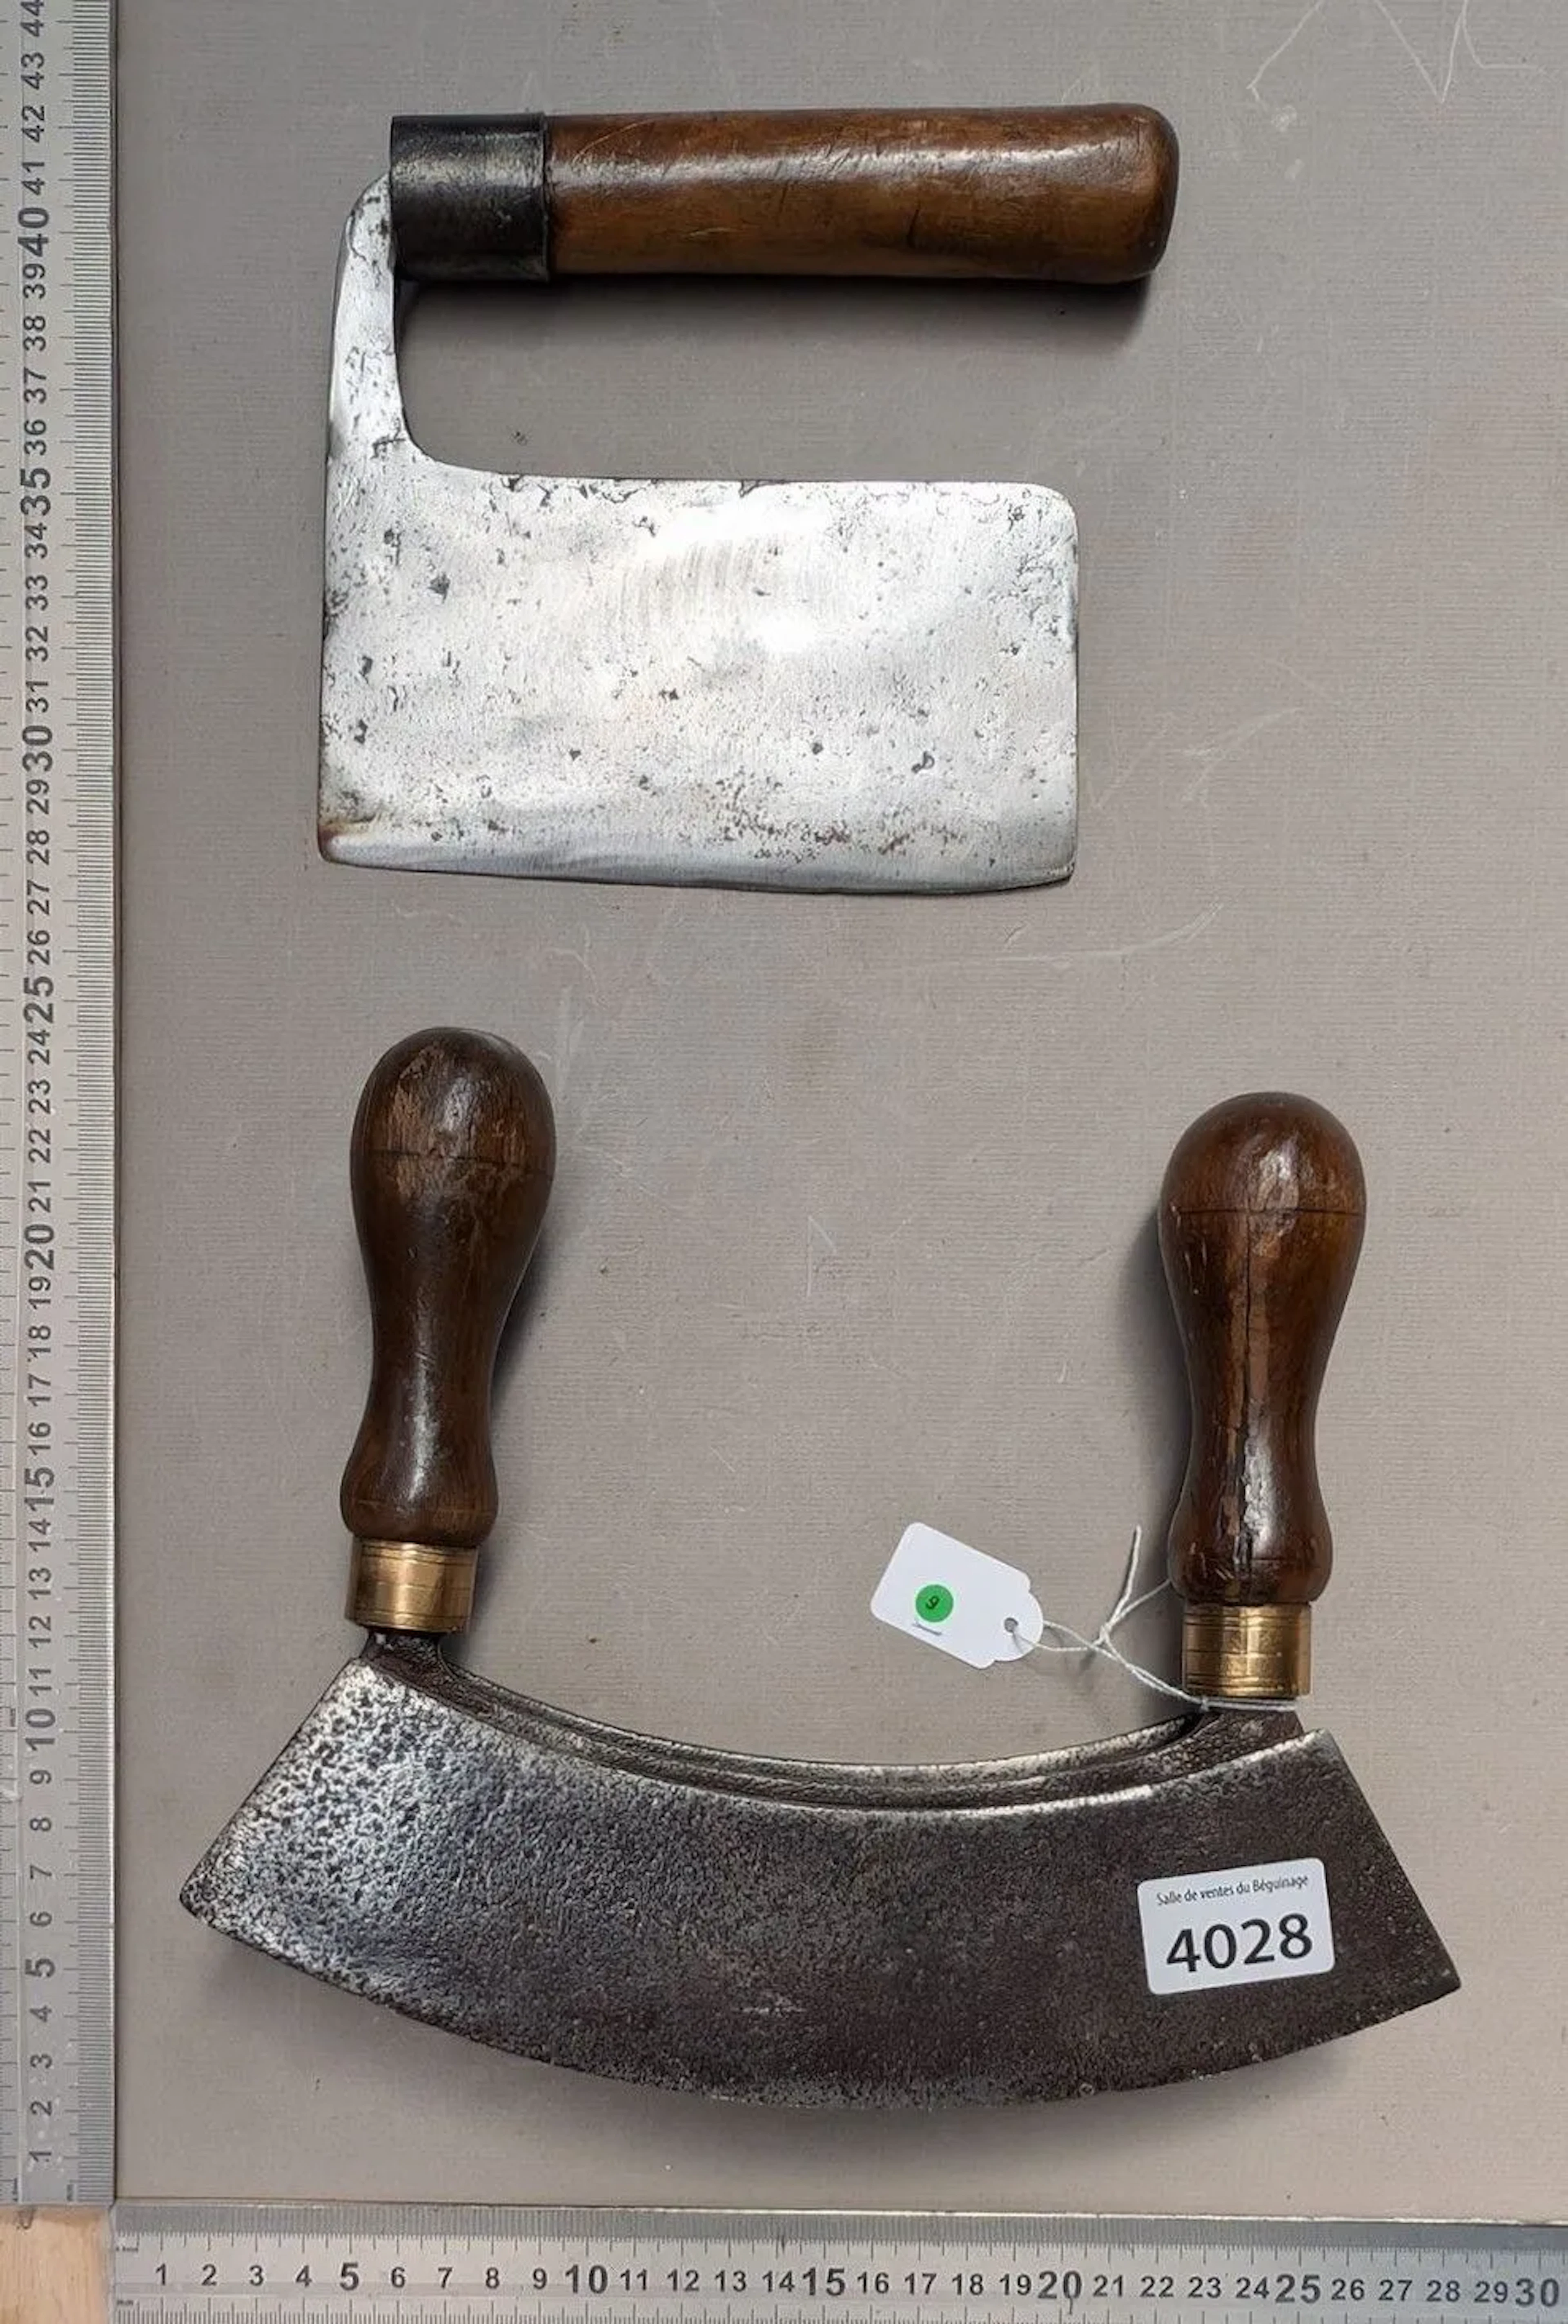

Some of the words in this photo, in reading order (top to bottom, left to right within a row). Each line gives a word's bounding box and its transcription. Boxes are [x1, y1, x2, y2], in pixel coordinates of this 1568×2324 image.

[20, 0, 45, 38] 44
[20, 52, 45, 91] 43
[21, 105, 45, 143] 42
[21, 161, 45, 196] 41
[17, 207, 50, 257] 40
[22, 263, 46, 300] 39
[22, 315, 47, 357] 38
[22, 366, 47, 404] 37
[23, 419, 47, 456] 36
[19, 468, 51, 517] 35
[24, 522, 48, 560] 34
[24, 575, 49, 611] 33
[24, 626, 49, 662] 32
[25, 680, 49, 714] 31
[21, 725, 53, 772] 30
[25, 779, 50, 815] 29
[25, 830, 50, 866] 28
[26, 879, 50, 916] 27
[26, 930, 51, 966] 26
[22, 976, 54, 1024] 25
[26, 1029, 51, 1066] 24
[26, 1079, 51, 1115] 23
[27, 1129, 51, 1164] 22
[27, 1181, 51, 1213] 21
[23, 1224, 55, 1271] 20
[27, 1276, 51, 1310] 19
[27, 1325, 51, 1358] 18
[27, 1373, 51, 1407] 17
[27, 1422, 51, 1456] 16
[23, 1467, 55, 1512] 15
[28, 1518, 51, 1552] 14
[27, 1568, 52, 1600] 13
[28, 1616, 51, 1648] 12
[28, 1668, 52, 1697] 11
[24, 1708, 56, 1751] 10
[29, 1770, 52, 1785] 9
[29, 1817, 52, 1832] 8
[29, 1865, 52, 1880] 7
[1156, 1891, 1182, 1906] Salle
[1184, 1889, 1198, 1901] de
[1200, 1884, 1234, 1899] ventes
[1236, 1882, 1250, 1894] du
[1253, 1875, 1309, 1893] Béguinage
[29, 1911, 52, 1927] 6
[1166, 1913, 1312, 1973] 4028
[24, 1958, 56, 1978] 5
[29, 2005, 52, 2023] 4
[29, 2054, 53, 2069] 3
[29, 2101, 52, 2116] 2
[29, 2151, 52, 2162] 1
[156, 2263, 166, 2286] 1
[201, 2264, 217, 2286] 2
[249, 2264, 264, 2287] 3
[295, 2264, 312, 2288] 4
[339, 2261, 359, 2292] 5
[390, 2266, 406, 2289] 6
[438, 2266, 453, 2290] 7
[485, 2266, 500, 2290] 8
[532, 2267, 548, 2291] 9
[565, 2264, 608, 2295] 10
[620, 2268, 648, 2291] 11
[667, 2268, 699, 2293] 12
[714, 2269, 747, 2293] 13
[762, 2270, 795, 2293] 14
[802, 2267, 846, 2297] 15
[857, 2271, 889, 2295] 16
[904, 2272, 937, 2296] 17
[951, 2273, 984, 2296] 18
[999, 2273, 1032, 2296] 19
[1037, 2270, 1084, 2301] 20
[1092, 2274, 1123, 2298] 21
[1139, 2275, 1174, 2299] 22
[1187, 2276, 1222, 2299] 23
[1235, 2276, 1270, 2299] 24
[1274, 2274, 1321, 2304] 25
[1331, 2278, 1365, 2302] 26
[1377, 2279, 1413, 2302] 27
[1425, 2279, 1461, 2303] 28
[1474, 2280, 1508, 2304] 29
[1515, 2278, 1559, 2308] 30
